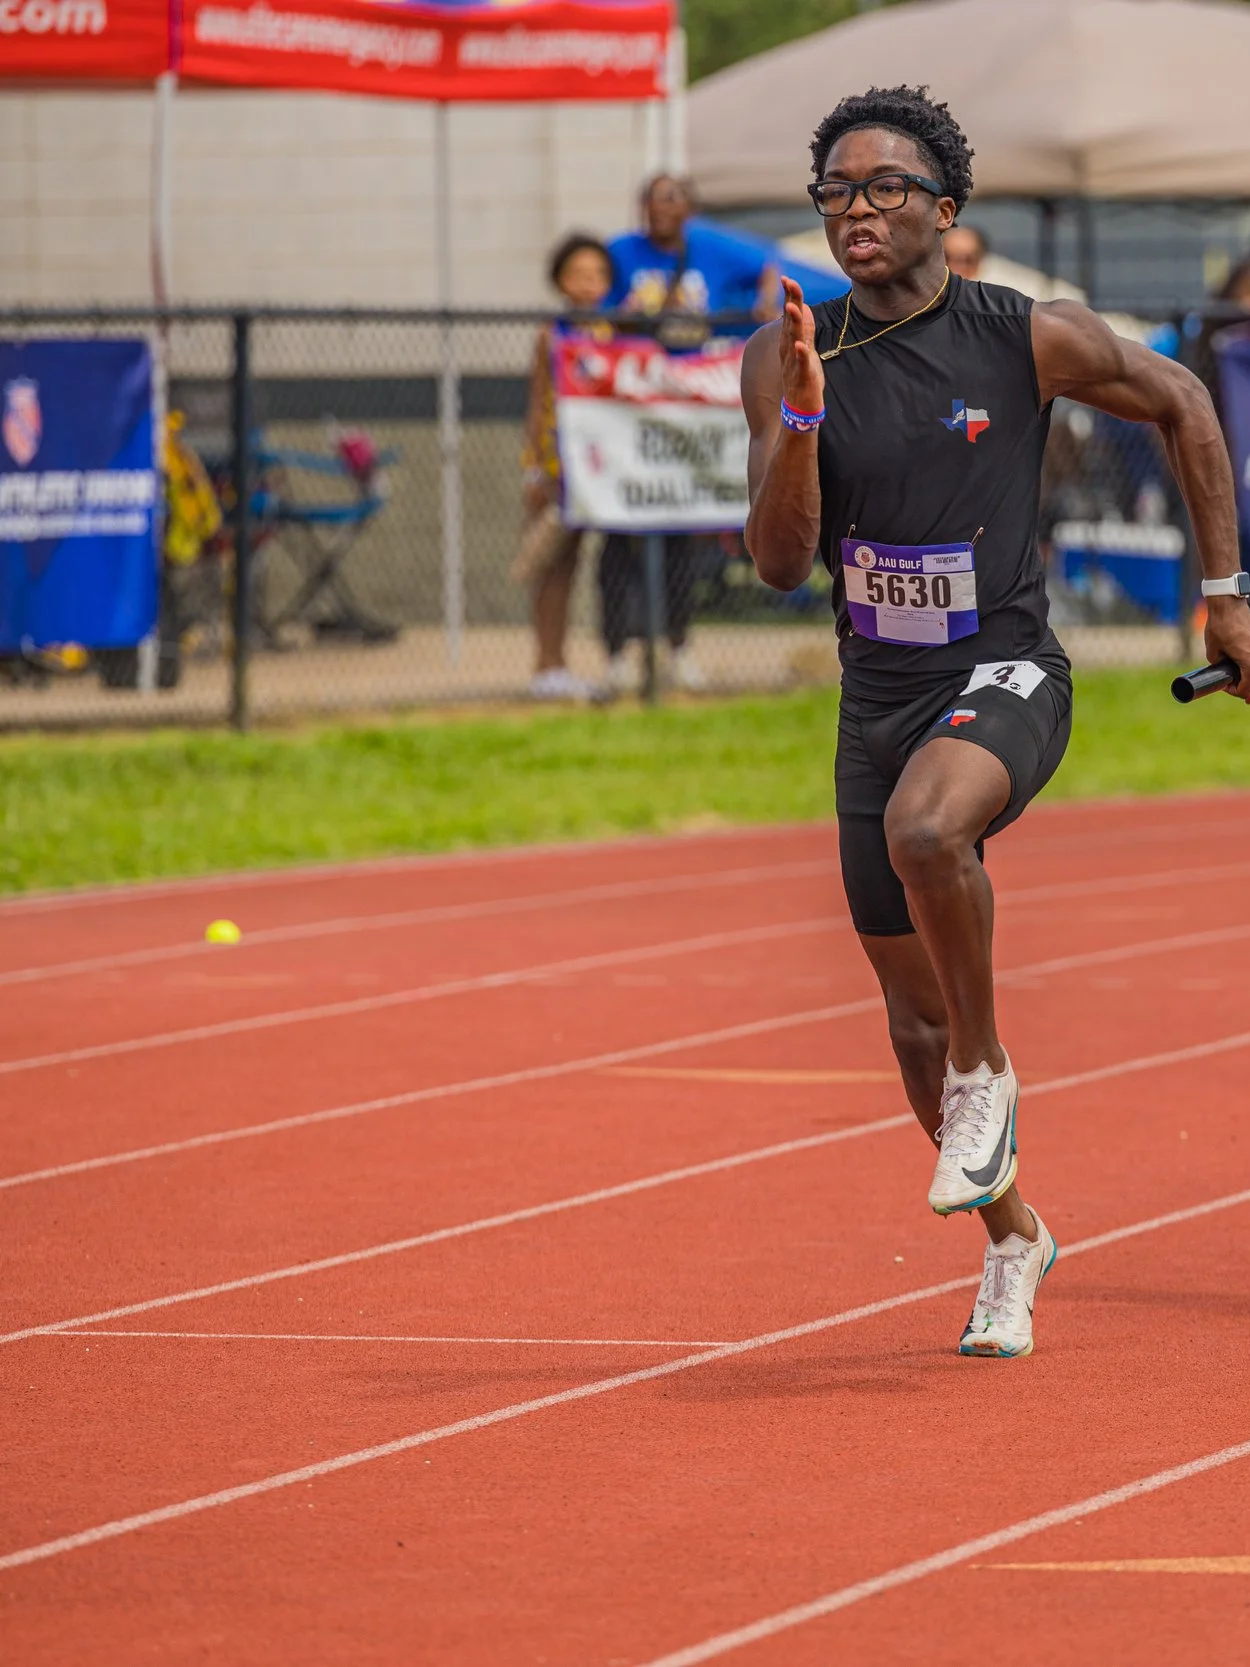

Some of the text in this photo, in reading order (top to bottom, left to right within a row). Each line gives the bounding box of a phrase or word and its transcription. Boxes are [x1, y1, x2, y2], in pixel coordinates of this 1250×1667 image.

[878, 556, 897, 569] AAU
[899, 559, 922, 570] GULF
[865, 571, 951, 608] 5630
